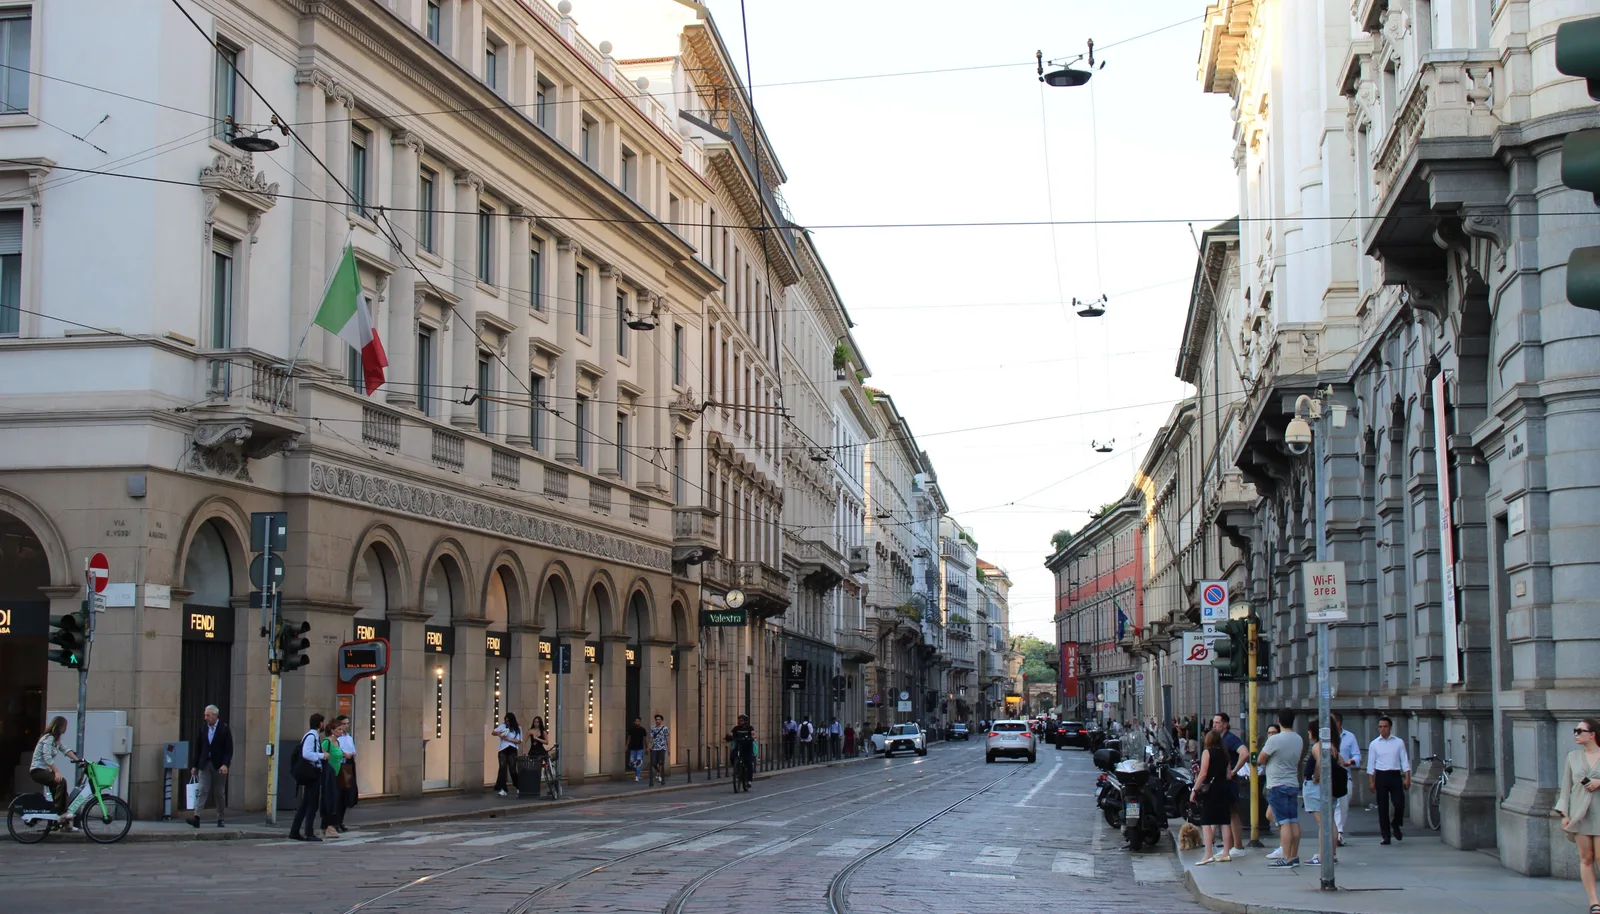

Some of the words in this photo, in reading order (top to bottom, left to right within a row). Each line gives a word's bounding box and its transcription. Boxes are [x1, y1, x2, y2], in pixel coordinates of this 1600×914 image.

[1312, 574, 1336, 586] Wi-Fi
[1313, 586, 1337, 596] area
[190, 613, 215, 631] FENDI
[709, 614, 742, 623] Valextra
[356, 625, 376, 640] FENDI
[426, 631, 443, 646] FENDI
[486, 636, 501, 650] FENDI
